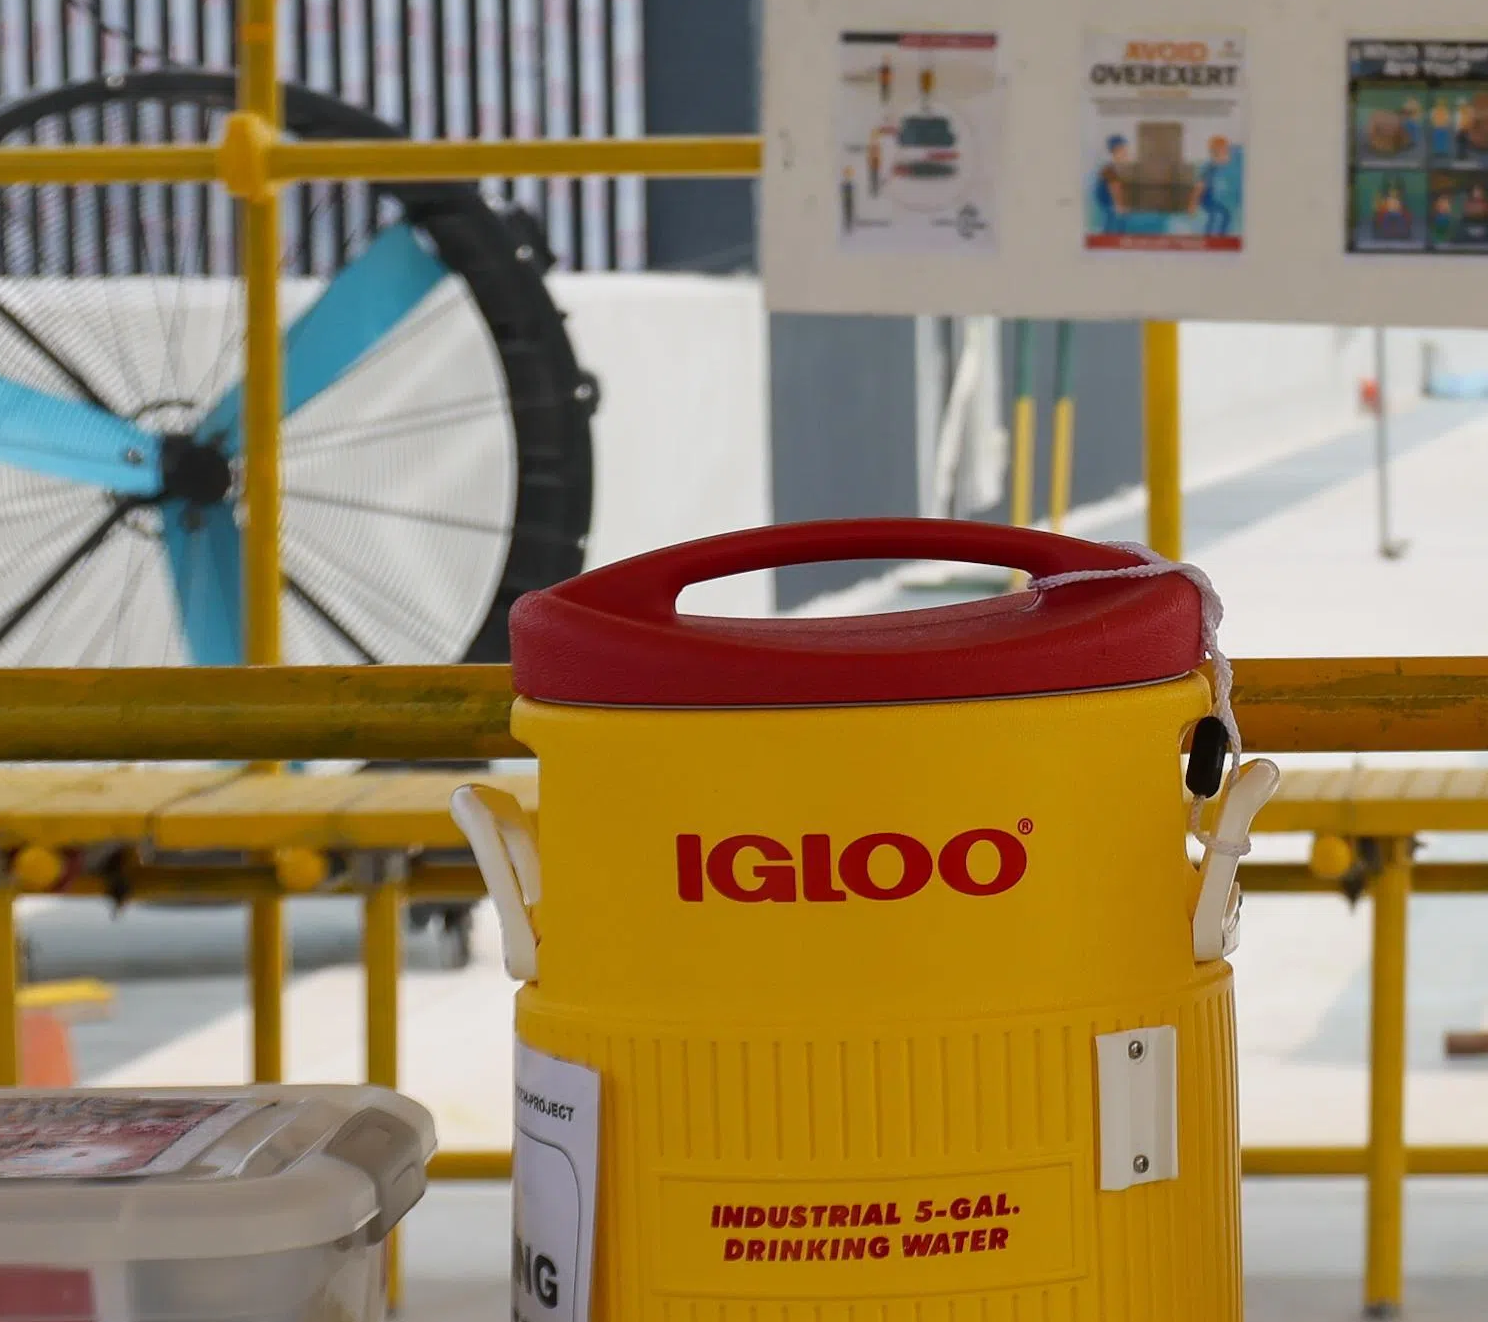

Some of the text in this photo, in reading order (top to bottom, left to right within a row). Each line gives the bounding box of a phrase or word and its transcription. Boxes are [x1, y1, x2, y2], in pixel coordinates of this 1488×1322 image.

[1123, 41, 1207, 62] AVOID
[1090, 63, 1238, 87] OVEREXERT
[710, 1192, 1022, 1229] INDUSTRIAL 5-GAL.
[722, 1227, 1010, 1262] DRINKING WATER
